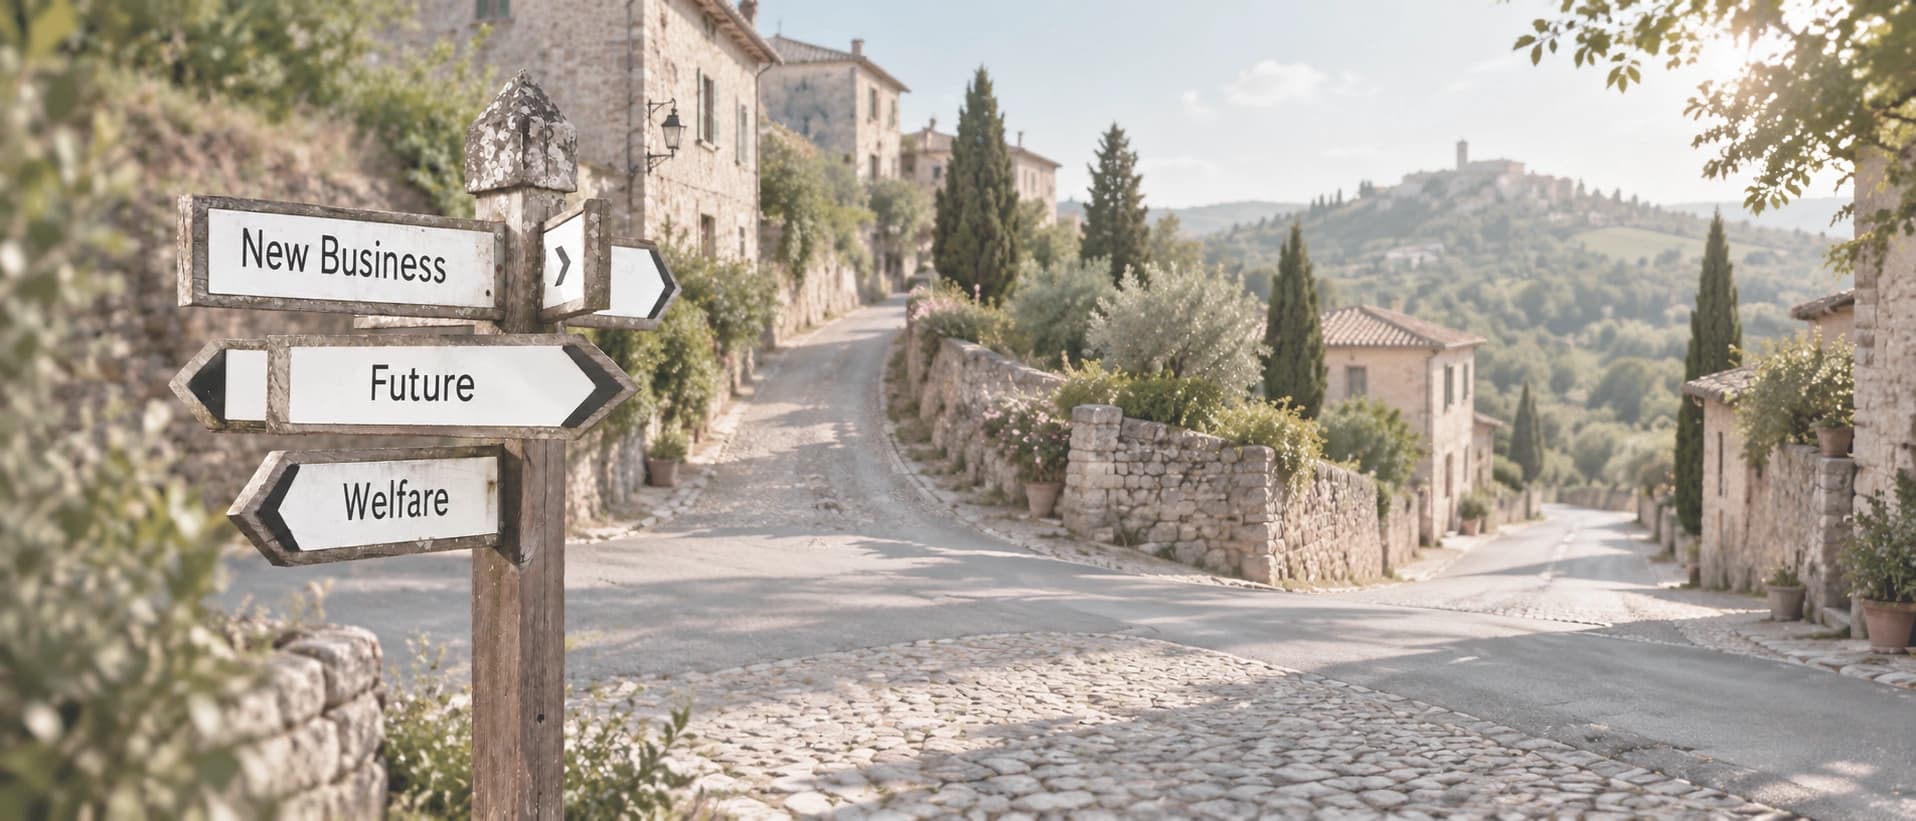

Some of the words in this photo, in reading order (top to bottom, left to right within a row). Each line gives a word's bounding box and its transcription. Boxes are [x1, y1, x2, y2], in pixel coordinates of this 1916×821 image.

[242, 229, 311, 273] New
[321, 235, 447, 284] Business
[370, 364, 475, 402] Future
[343, 478, 449, 520] Welfare
